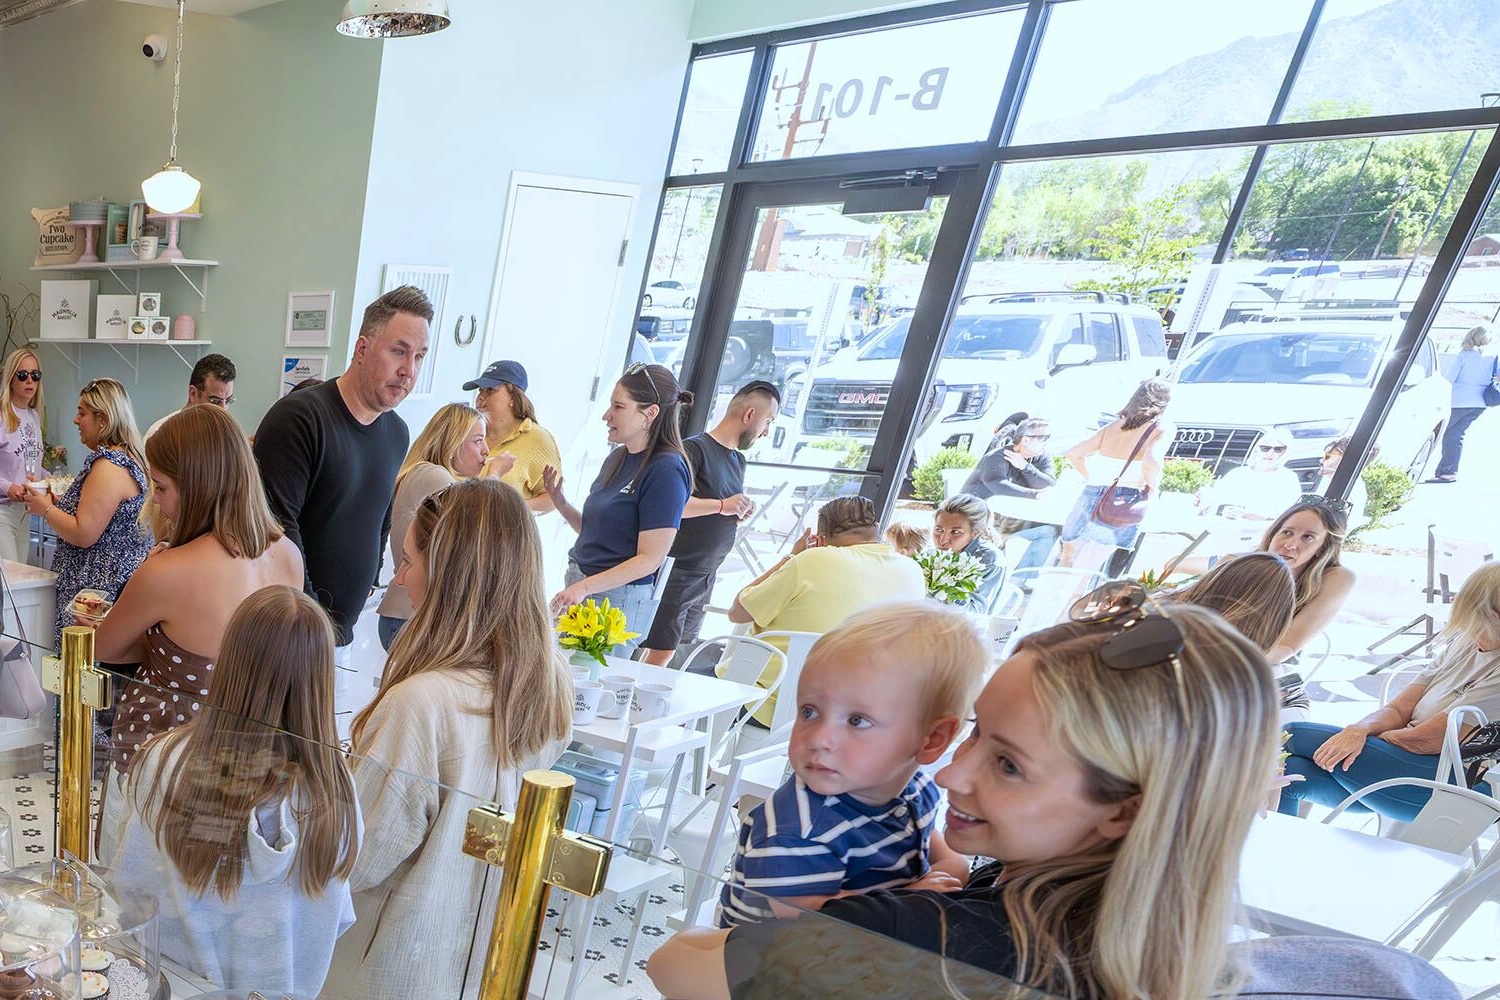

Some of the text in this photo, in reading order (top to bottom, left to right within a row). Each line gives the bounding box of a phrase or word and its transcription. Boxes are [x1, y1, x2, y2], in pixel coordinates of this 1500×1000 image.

[48, 224, 66, 234] Two
[40, 233, 75, 246] Cupcake
[51, 309, 77, 319] MAGNOLIA
[838, 393, 889, 404] GMC
